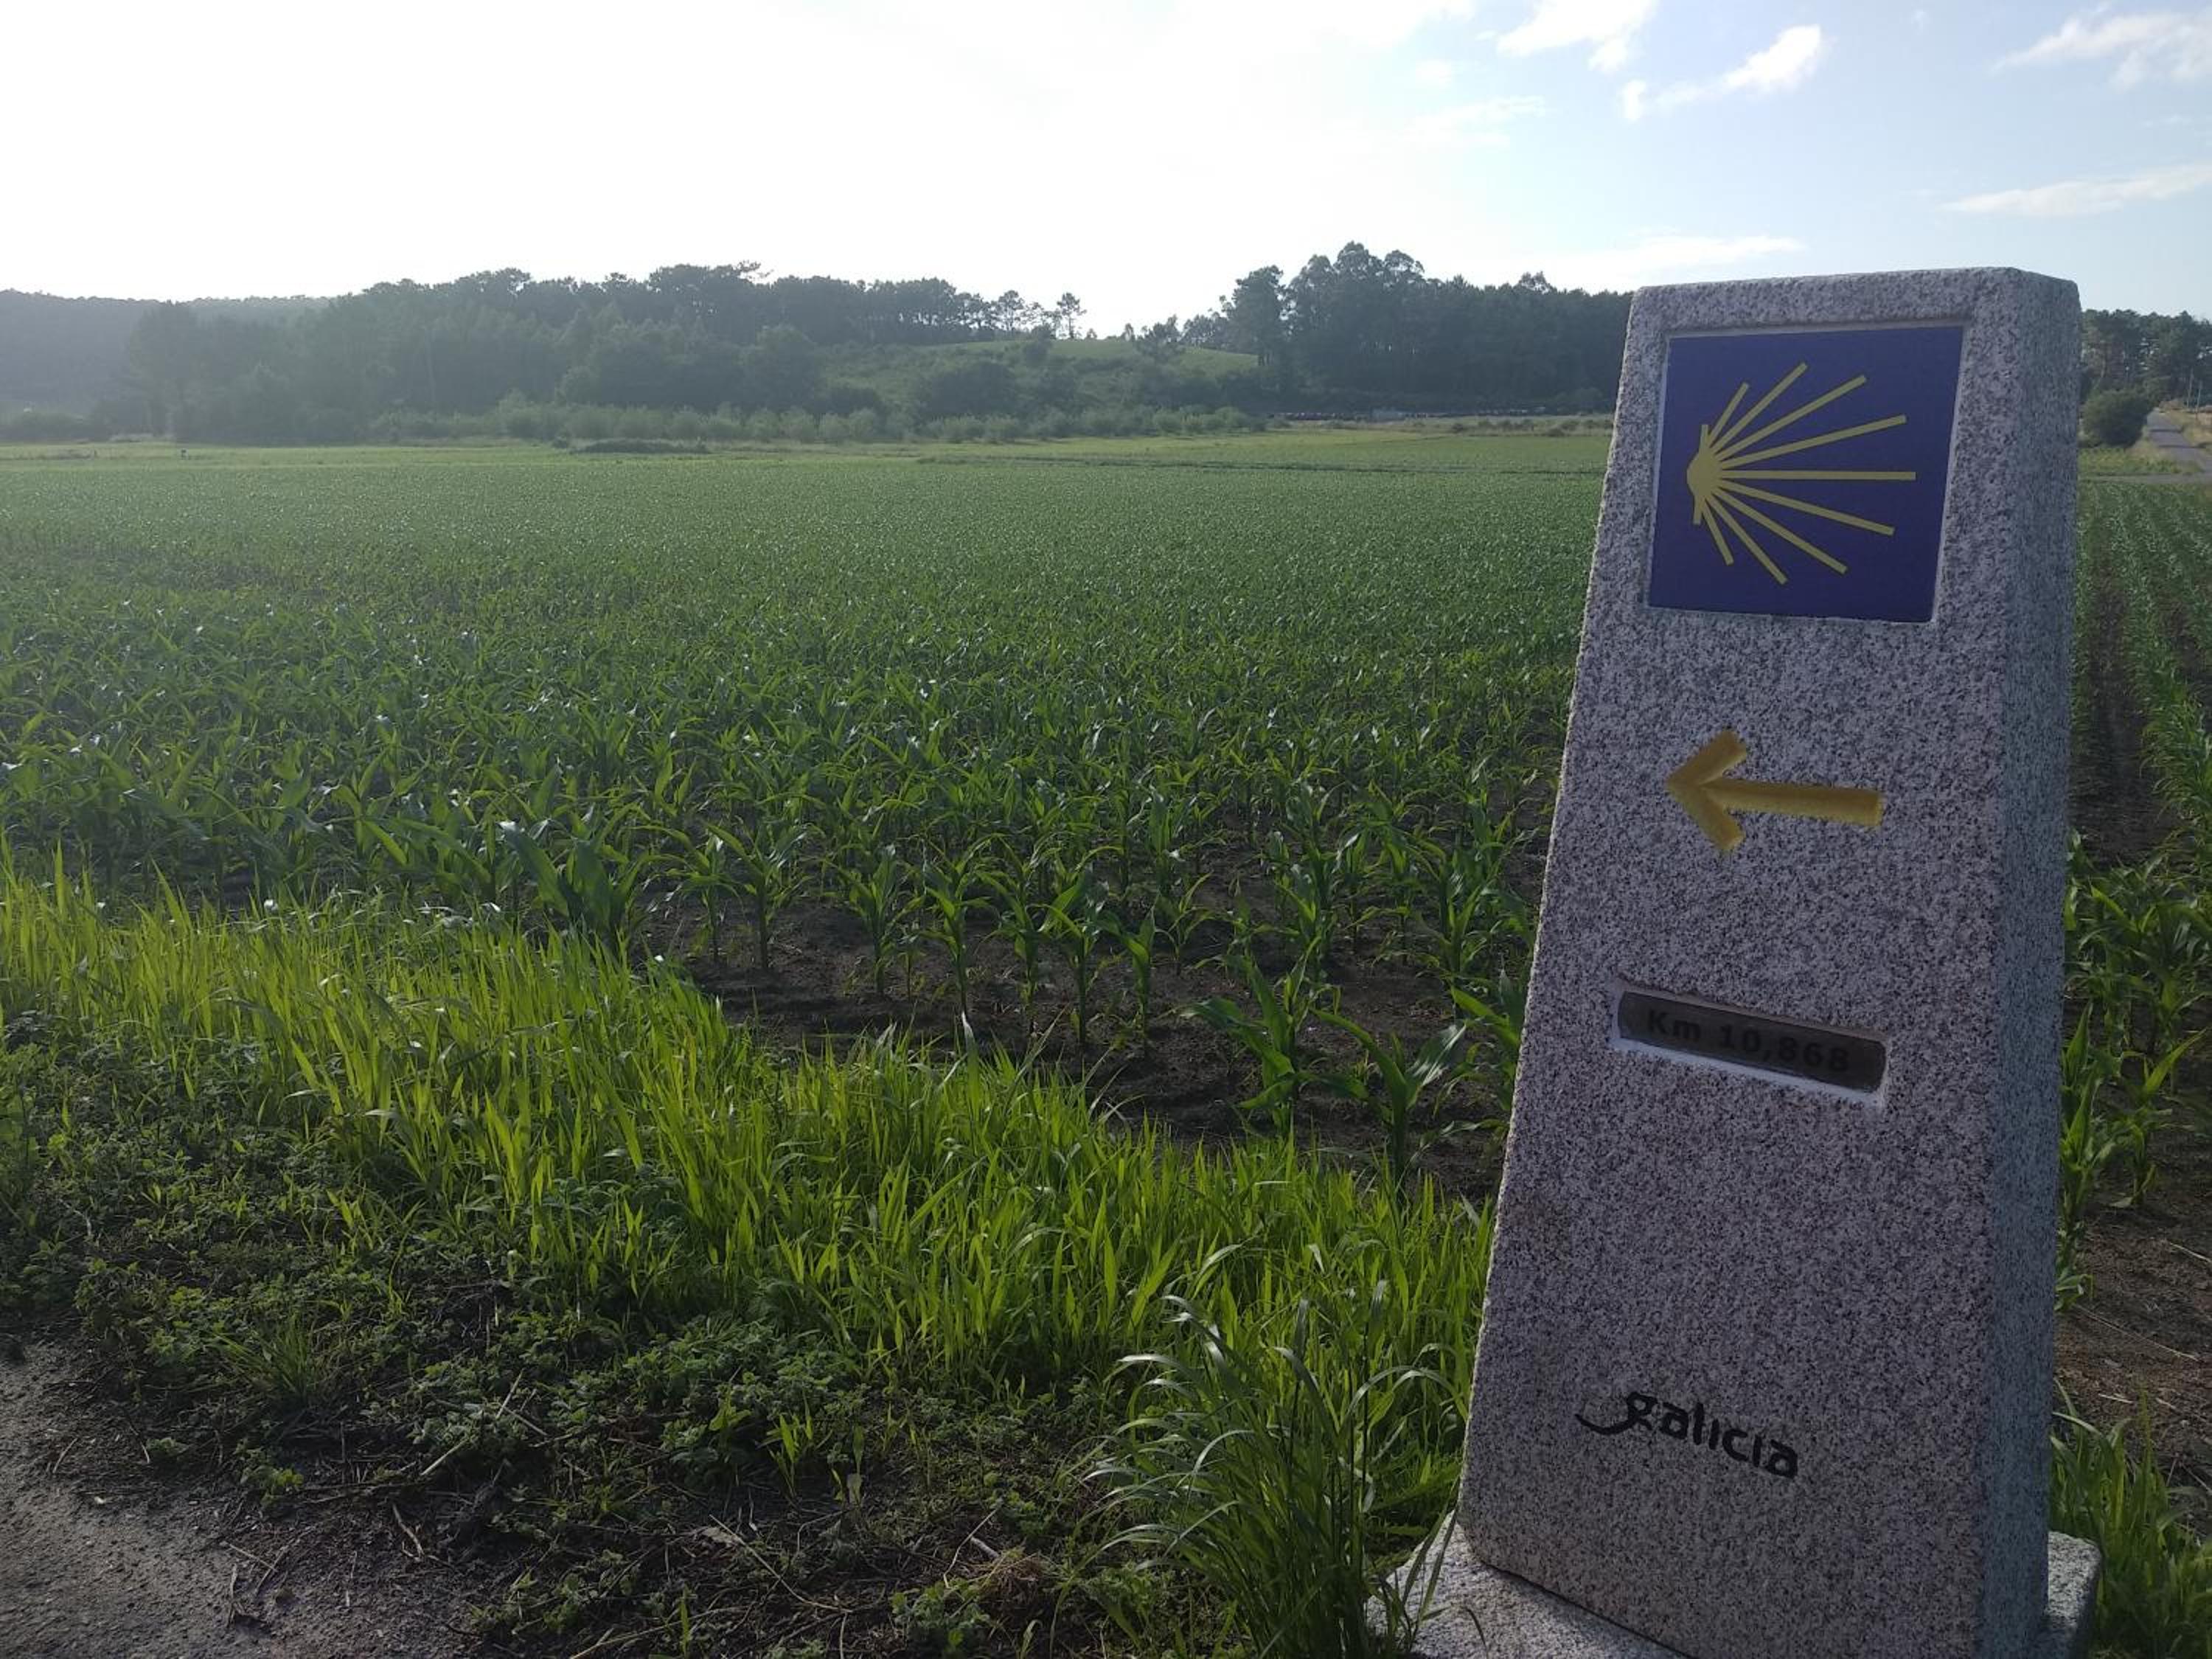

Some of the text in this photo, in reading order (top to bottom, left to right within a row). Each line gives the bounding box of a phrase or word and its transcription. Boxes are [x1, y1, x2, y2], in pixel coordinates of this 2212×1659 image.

[1647, 1009, 1849, 1073] Km 10,868
[1574, 1391, 1798, 1479] galicia
